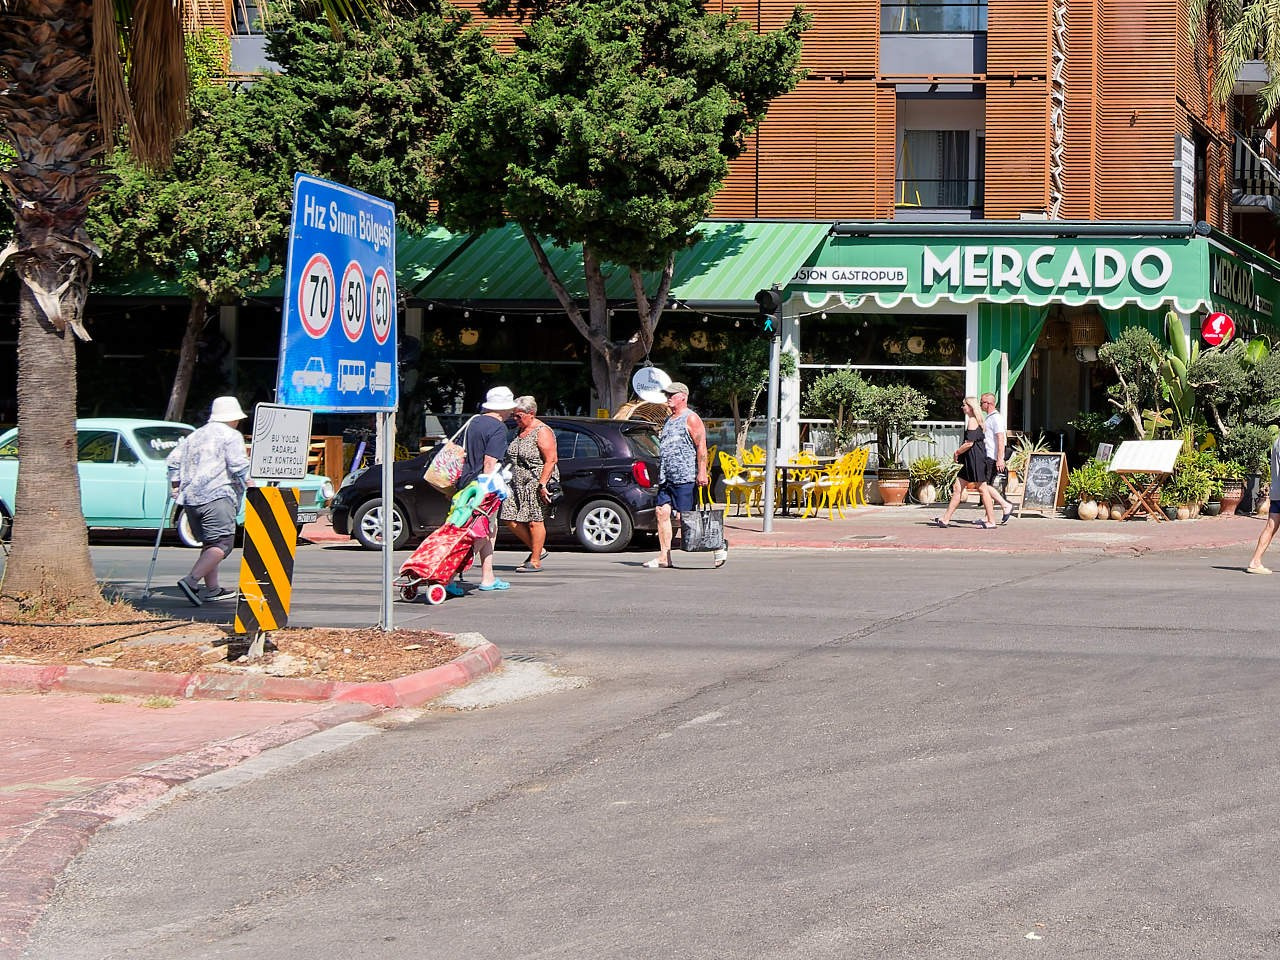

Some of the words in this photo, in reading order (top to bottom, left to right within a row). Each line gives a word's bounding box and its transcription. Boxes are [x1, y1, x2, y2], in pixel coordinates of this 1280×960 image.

[359, 210, 392, 252] Bölgesi
[791, 269, 828, 281] USION
[831, 269, 905, 281] GASTROPUB
[919, 245, 1173, 292] MERCADO
[1213, 253, 1255, 309] MERCADO
[309, 275, 329, 319] 70
[347, 281, 362, 322] 50
[376, 286, 388, 327] 50
[271, 434, 280, 442] BU
[282, 434, 300, 443] YOLDA
[271, 445, 297, 454] RADARLA
[259, 466, 303, 476] YAPILMAKTADIR
[262, 456, 273, 464] HIZ
